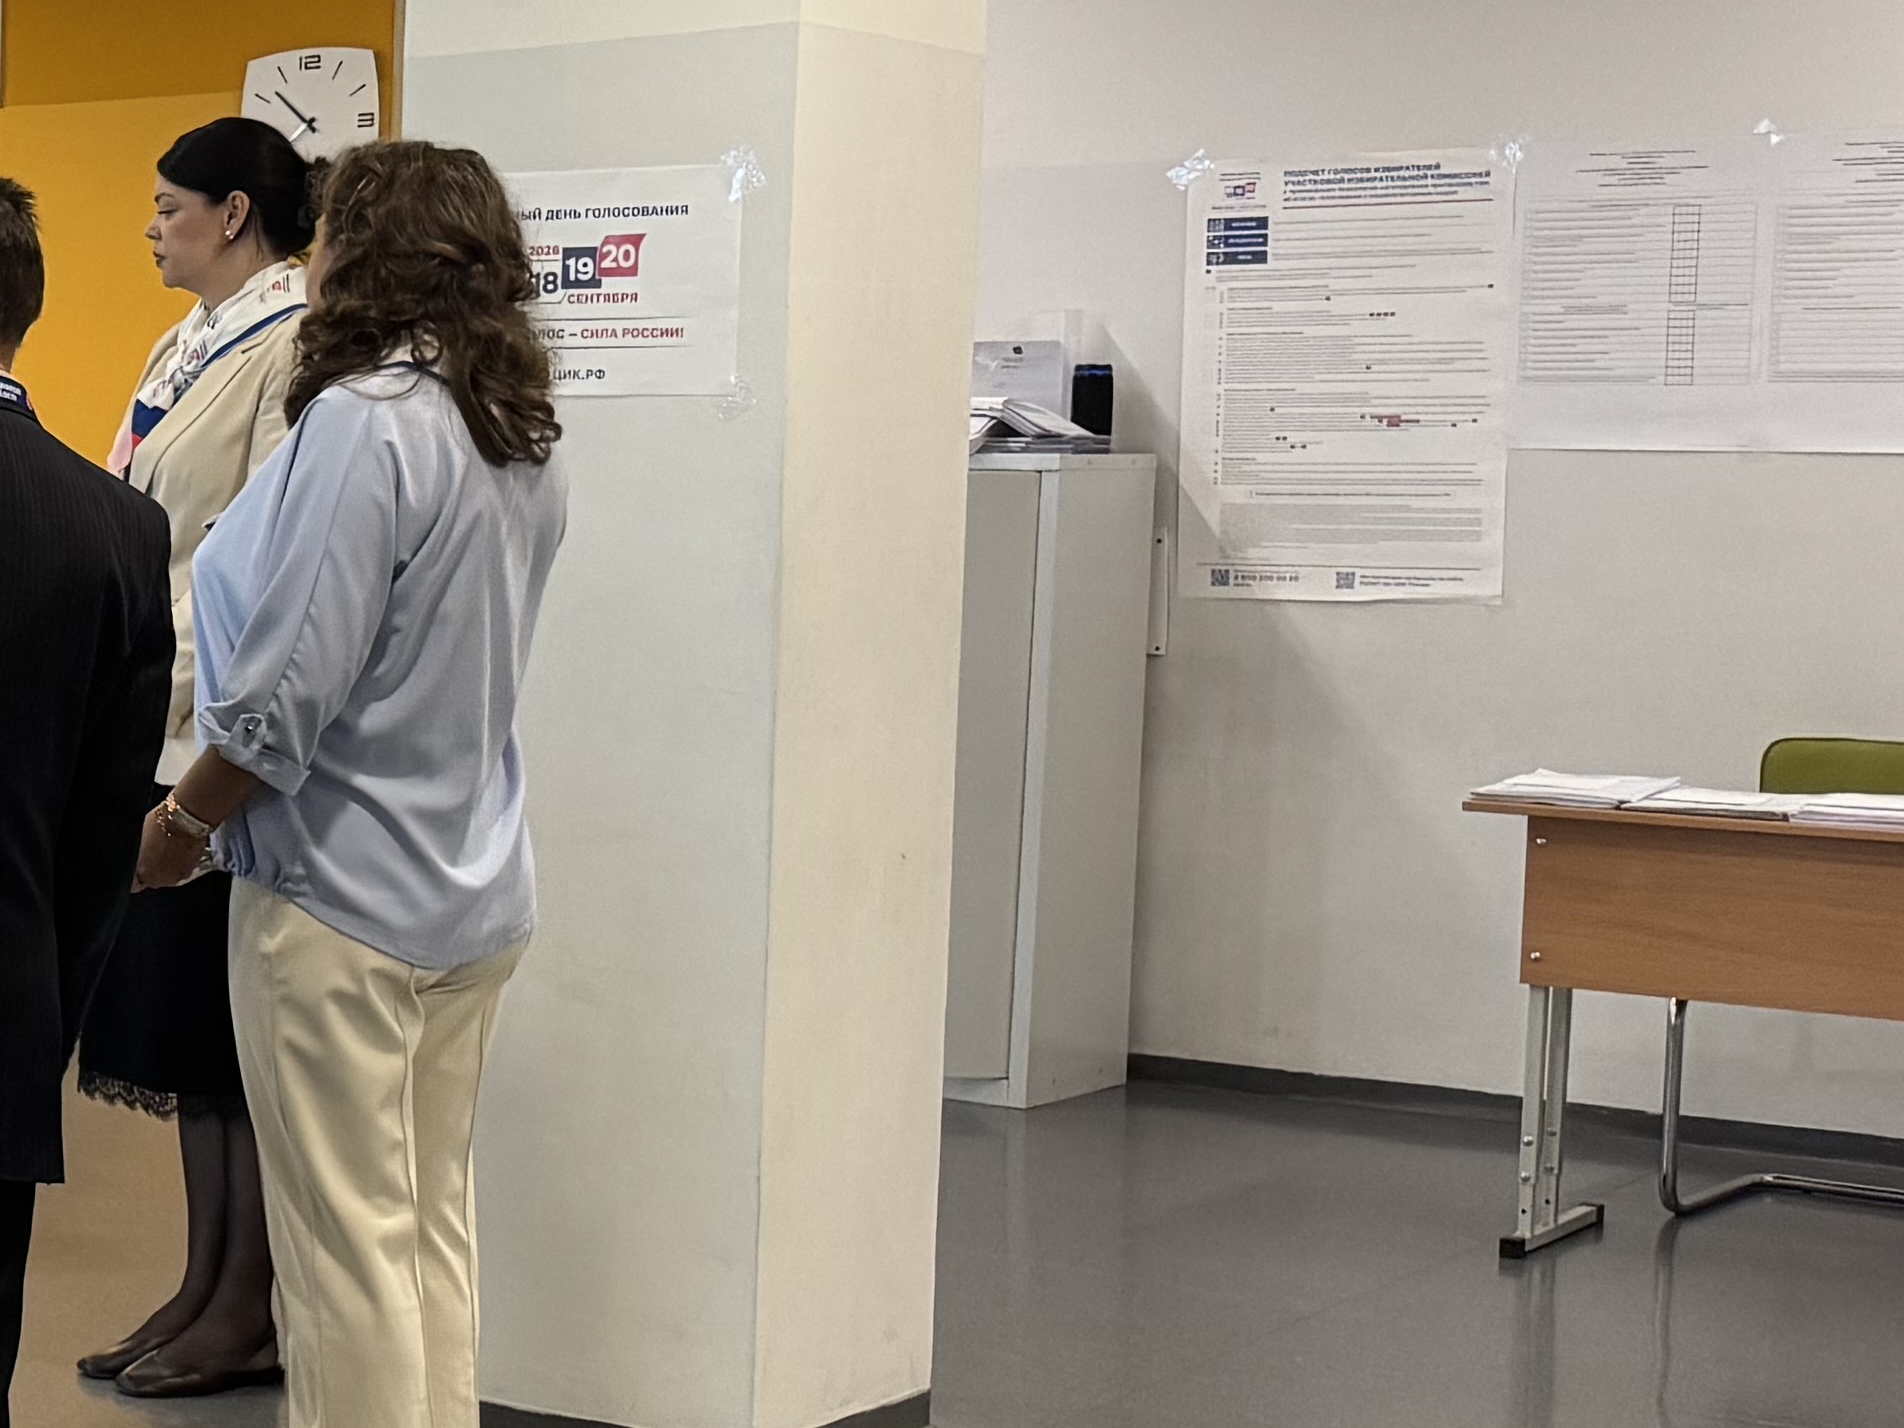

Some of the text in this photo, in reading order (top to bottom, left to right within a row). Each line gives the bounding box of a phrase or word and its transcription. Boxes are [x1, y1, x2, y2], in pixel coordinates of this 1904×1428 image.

[299, 54, 321, 71] 12
[357, 112, 375, 128] 3
[545, 208, 581, 221] ДЕНЬ
[585, 205, 689, 219] ГОЛОСОВАНИЯ
[565, 256, 594, 281] 19
[600, 244, 636, 269] 20
[567, 292, 638, 304] СЕНТЯБРЯ
[580, 328, 618, 339] СИЛА
[622, 327, 684, 339] РОССИИ!
